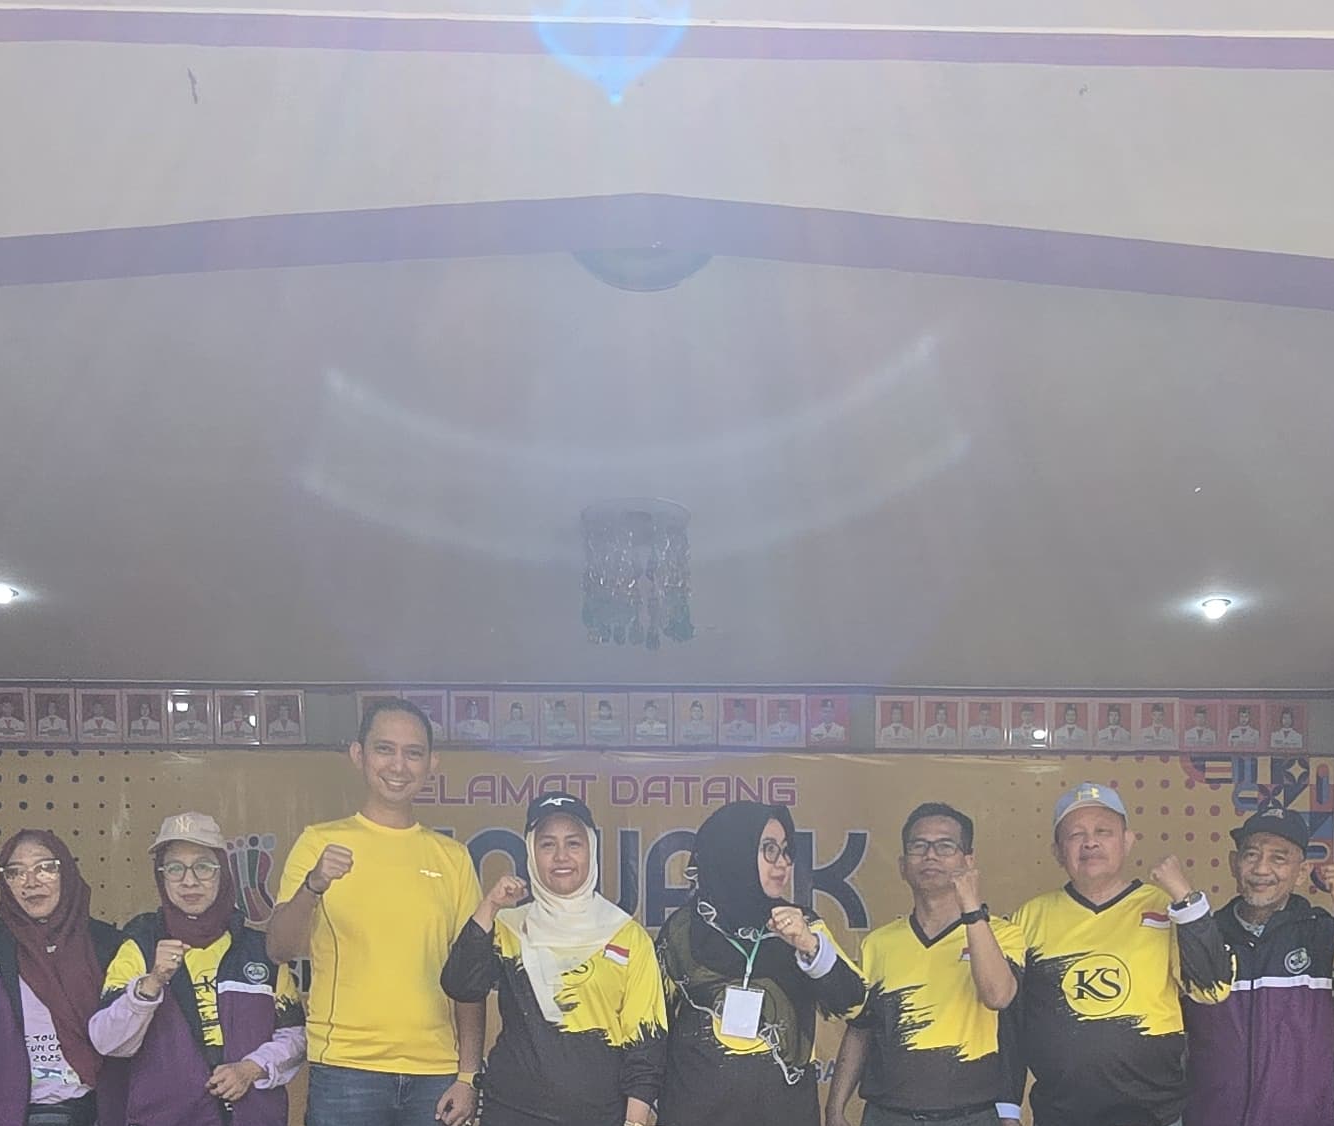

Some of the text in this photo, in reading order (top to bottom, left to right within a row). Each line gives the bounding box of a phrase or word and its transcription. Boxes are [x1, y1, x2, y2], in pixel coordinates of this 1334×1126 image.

[611, 775, 797, 807] DATANG
[1072, 966, 1122, 1003] KS
[32, 1053, 63, 1063] 2025
